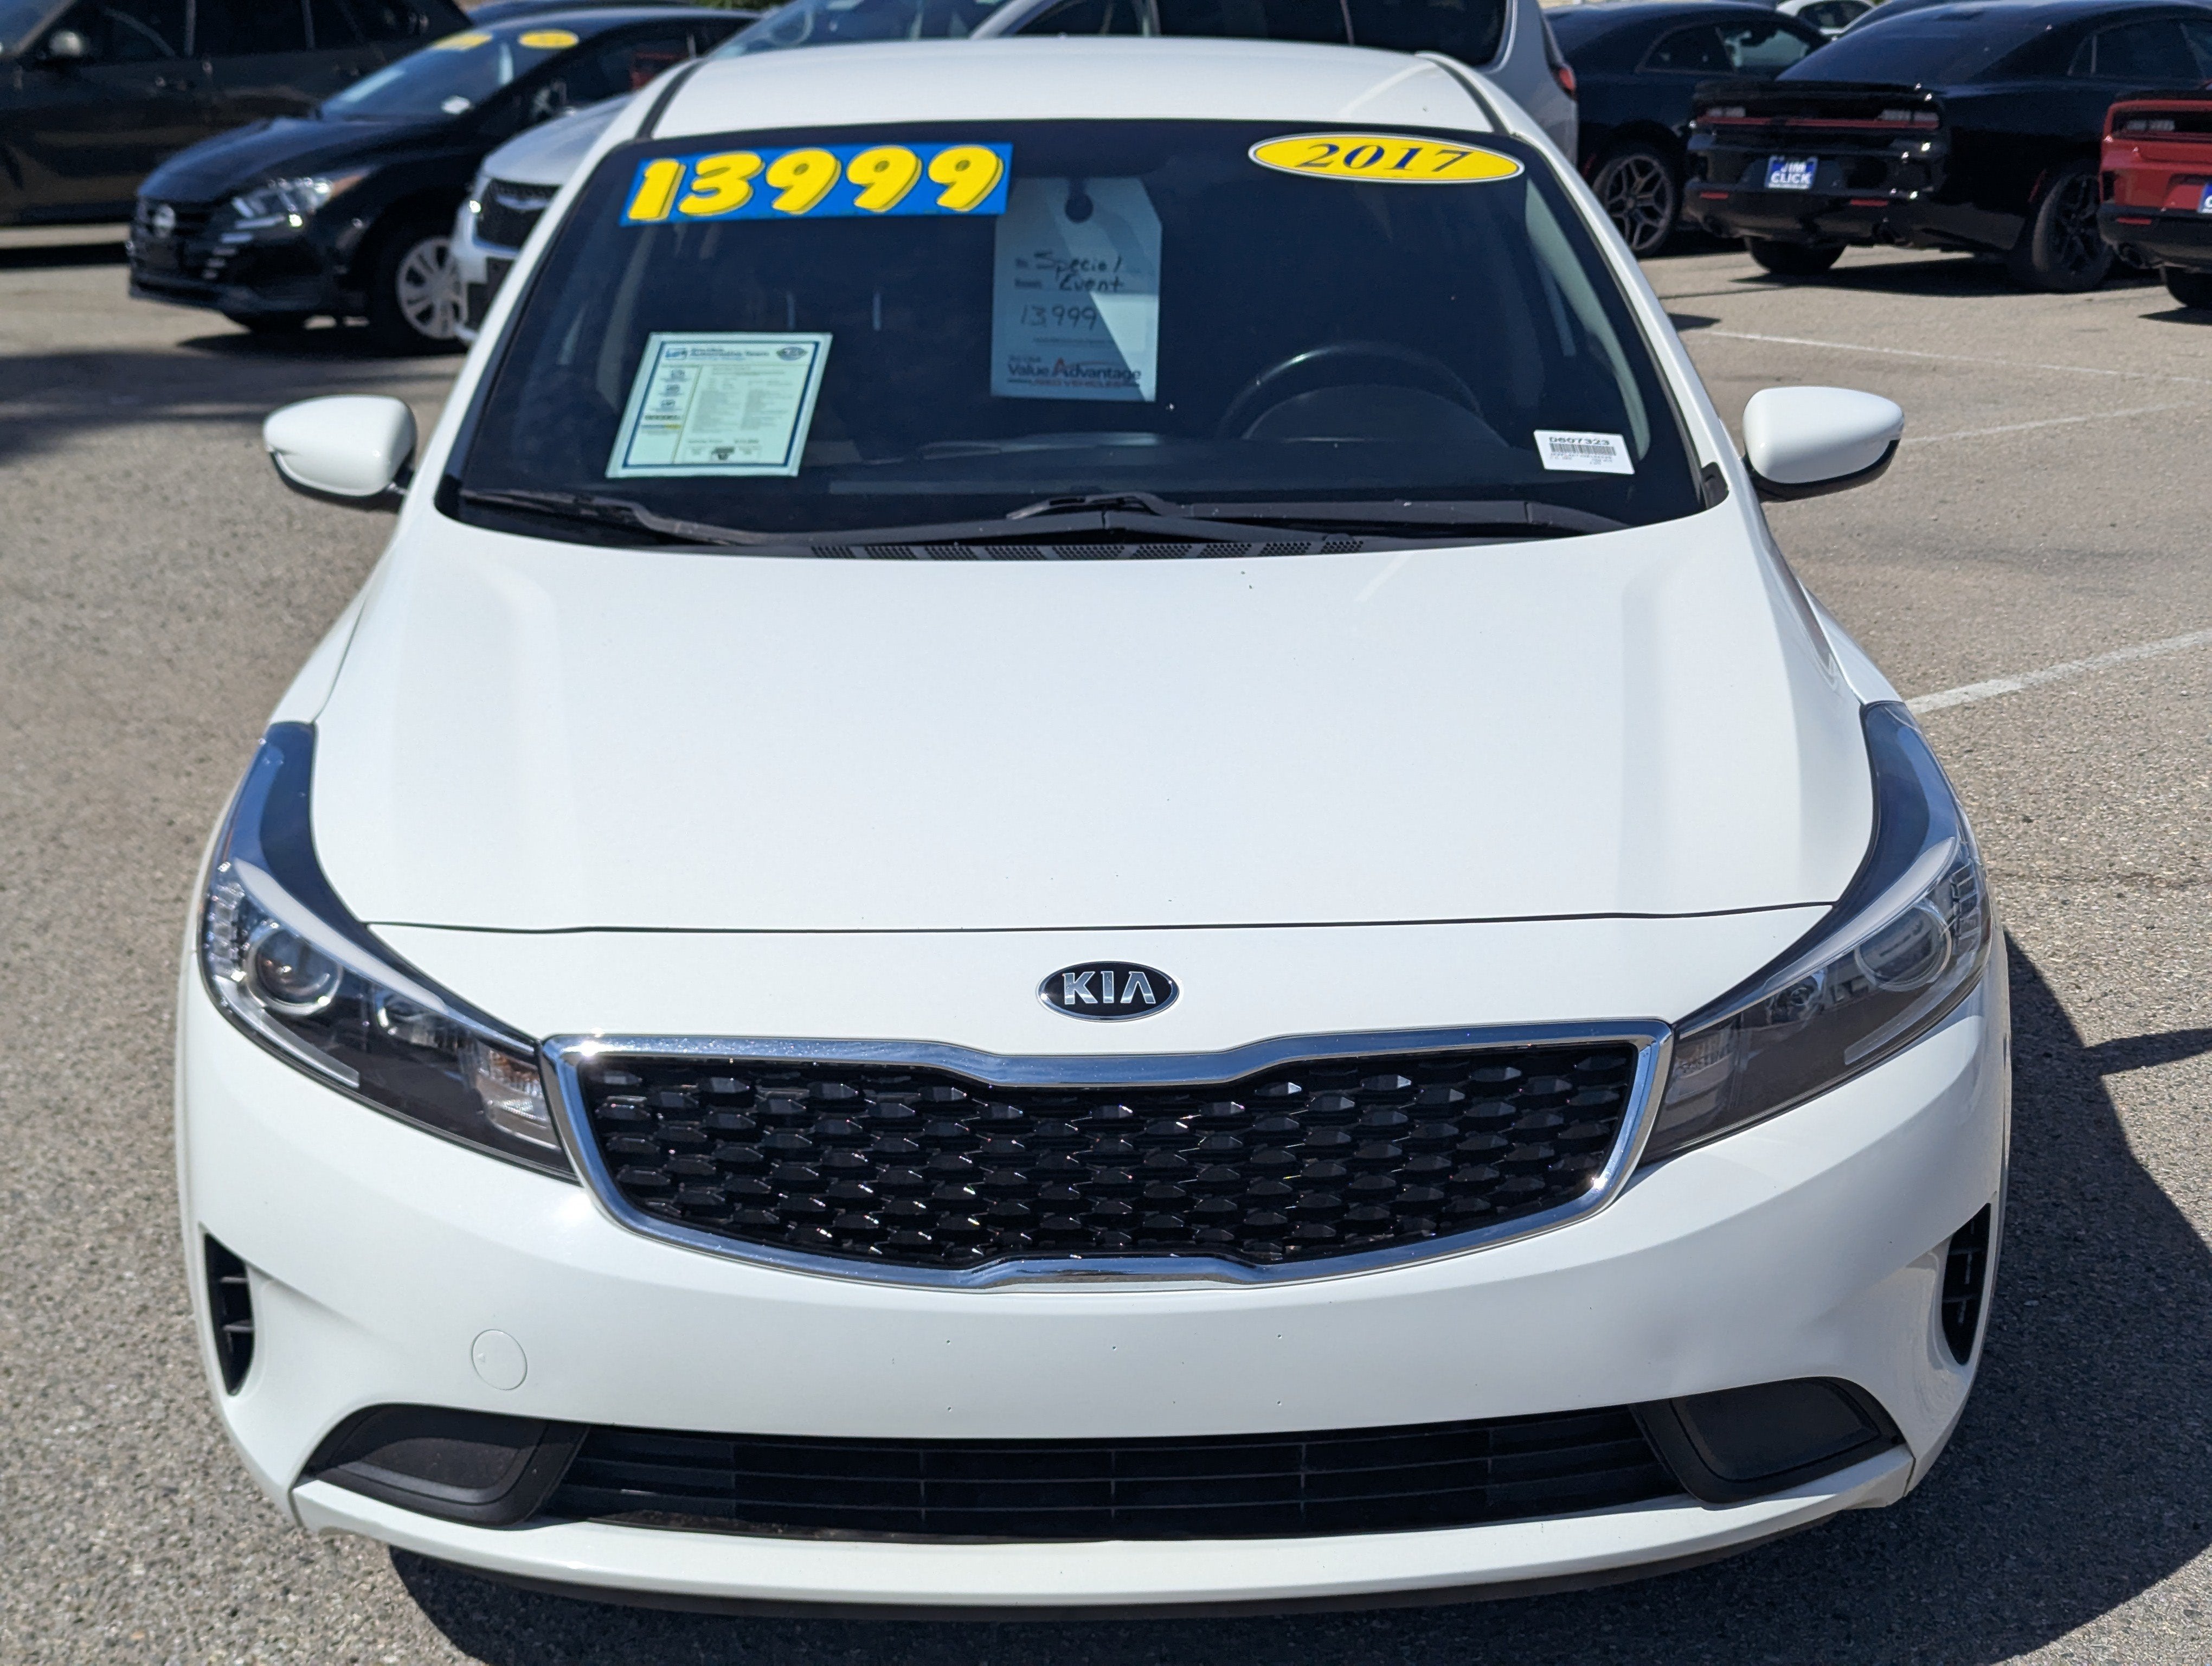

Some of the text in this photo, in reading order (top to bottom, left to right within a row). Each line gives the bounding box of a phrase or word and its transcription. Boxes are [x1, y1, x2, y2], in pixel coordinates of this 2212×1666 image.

[1294, 143, 1474, 173] 2017
[1780, 162, 1806, 173] JIM
[628, 144, 1004, 221] 13999
[1771, 170, 1811, 184] CLICK
[1034, 251, 1122, 281] Special
[1059, 273, 1124, 293] Event
[1020, 304, 1098, 331] 13999
[1007, 363, 1050, 376] Value
[1052, 357, 1142, 382] Advantage
[1062, 971, 1156, 1005] KIA
